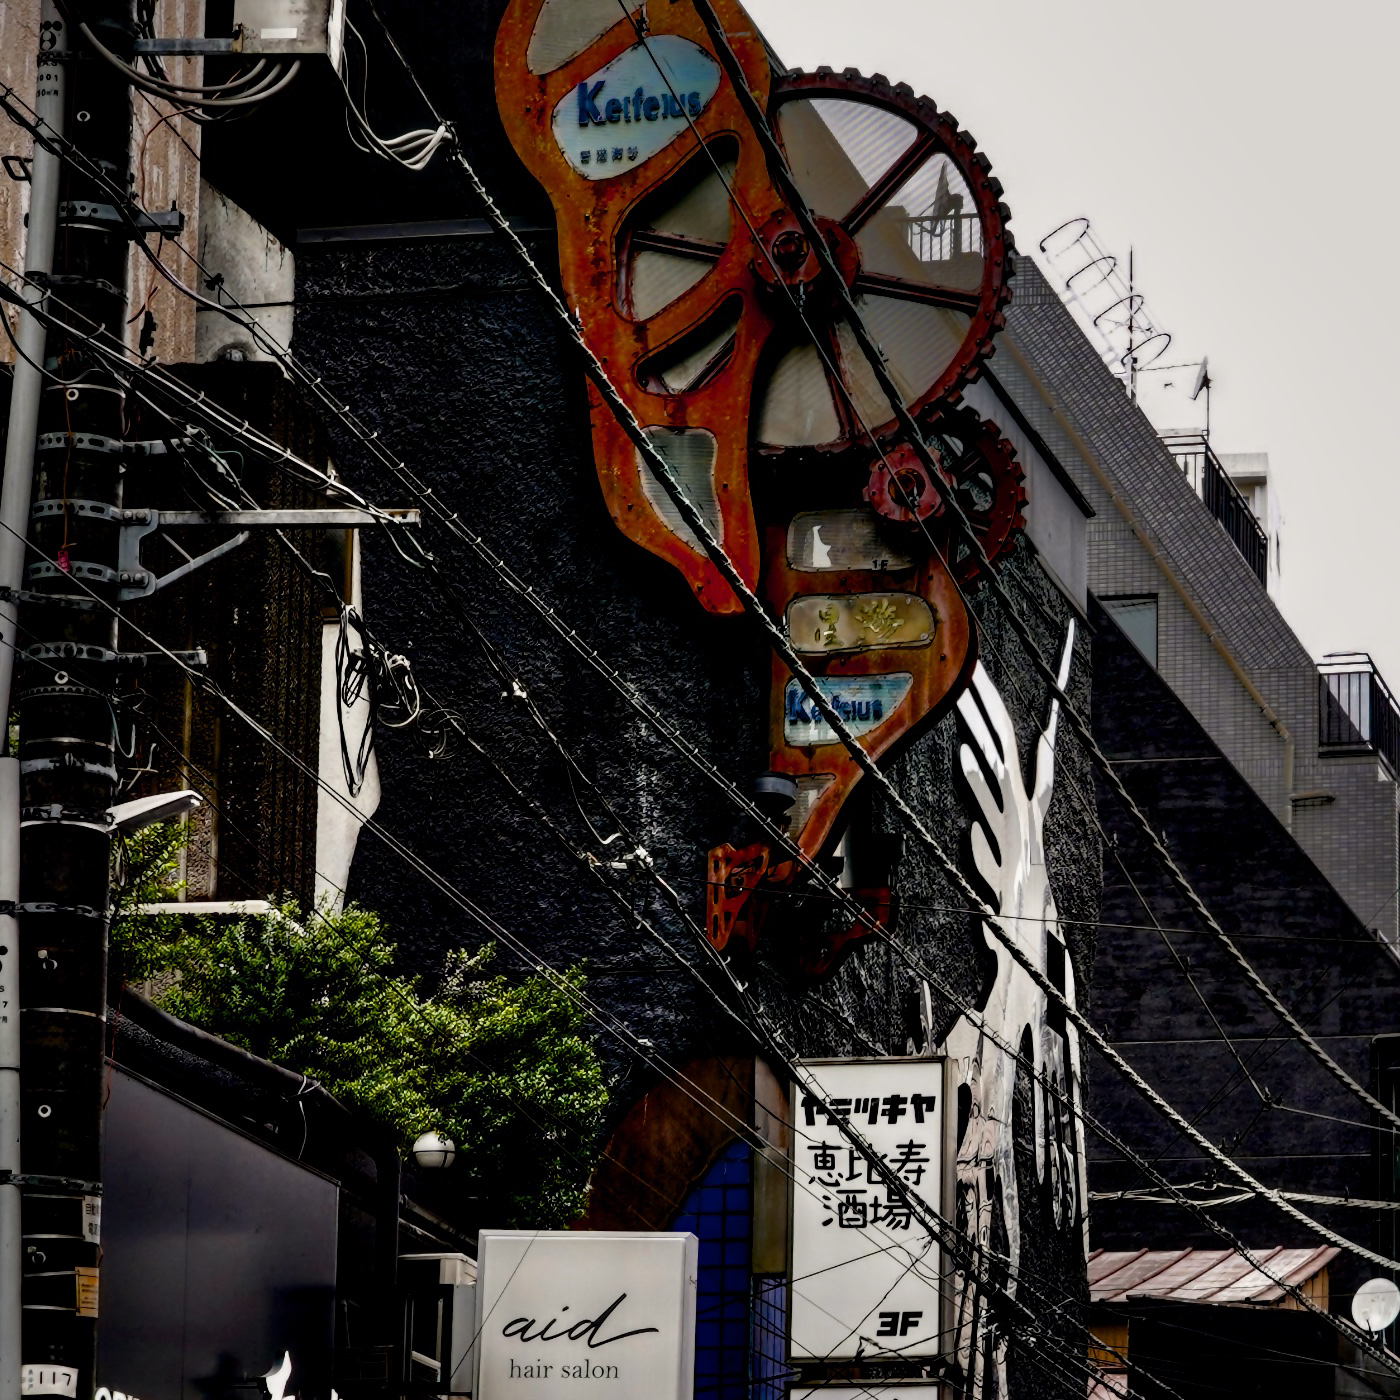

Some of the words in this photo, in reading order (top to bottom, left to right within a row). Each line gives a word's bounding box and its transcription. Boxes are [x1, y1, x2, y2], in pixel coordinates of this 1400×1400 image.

[822, 1189, 914, 1231] 酒場
[501, 1292, 659, 1349] aid
[876, 1311, 923, 1336] 3F
[509, 1358, 554, 1380] hair
[560, 1358, 619, 1380] salon
